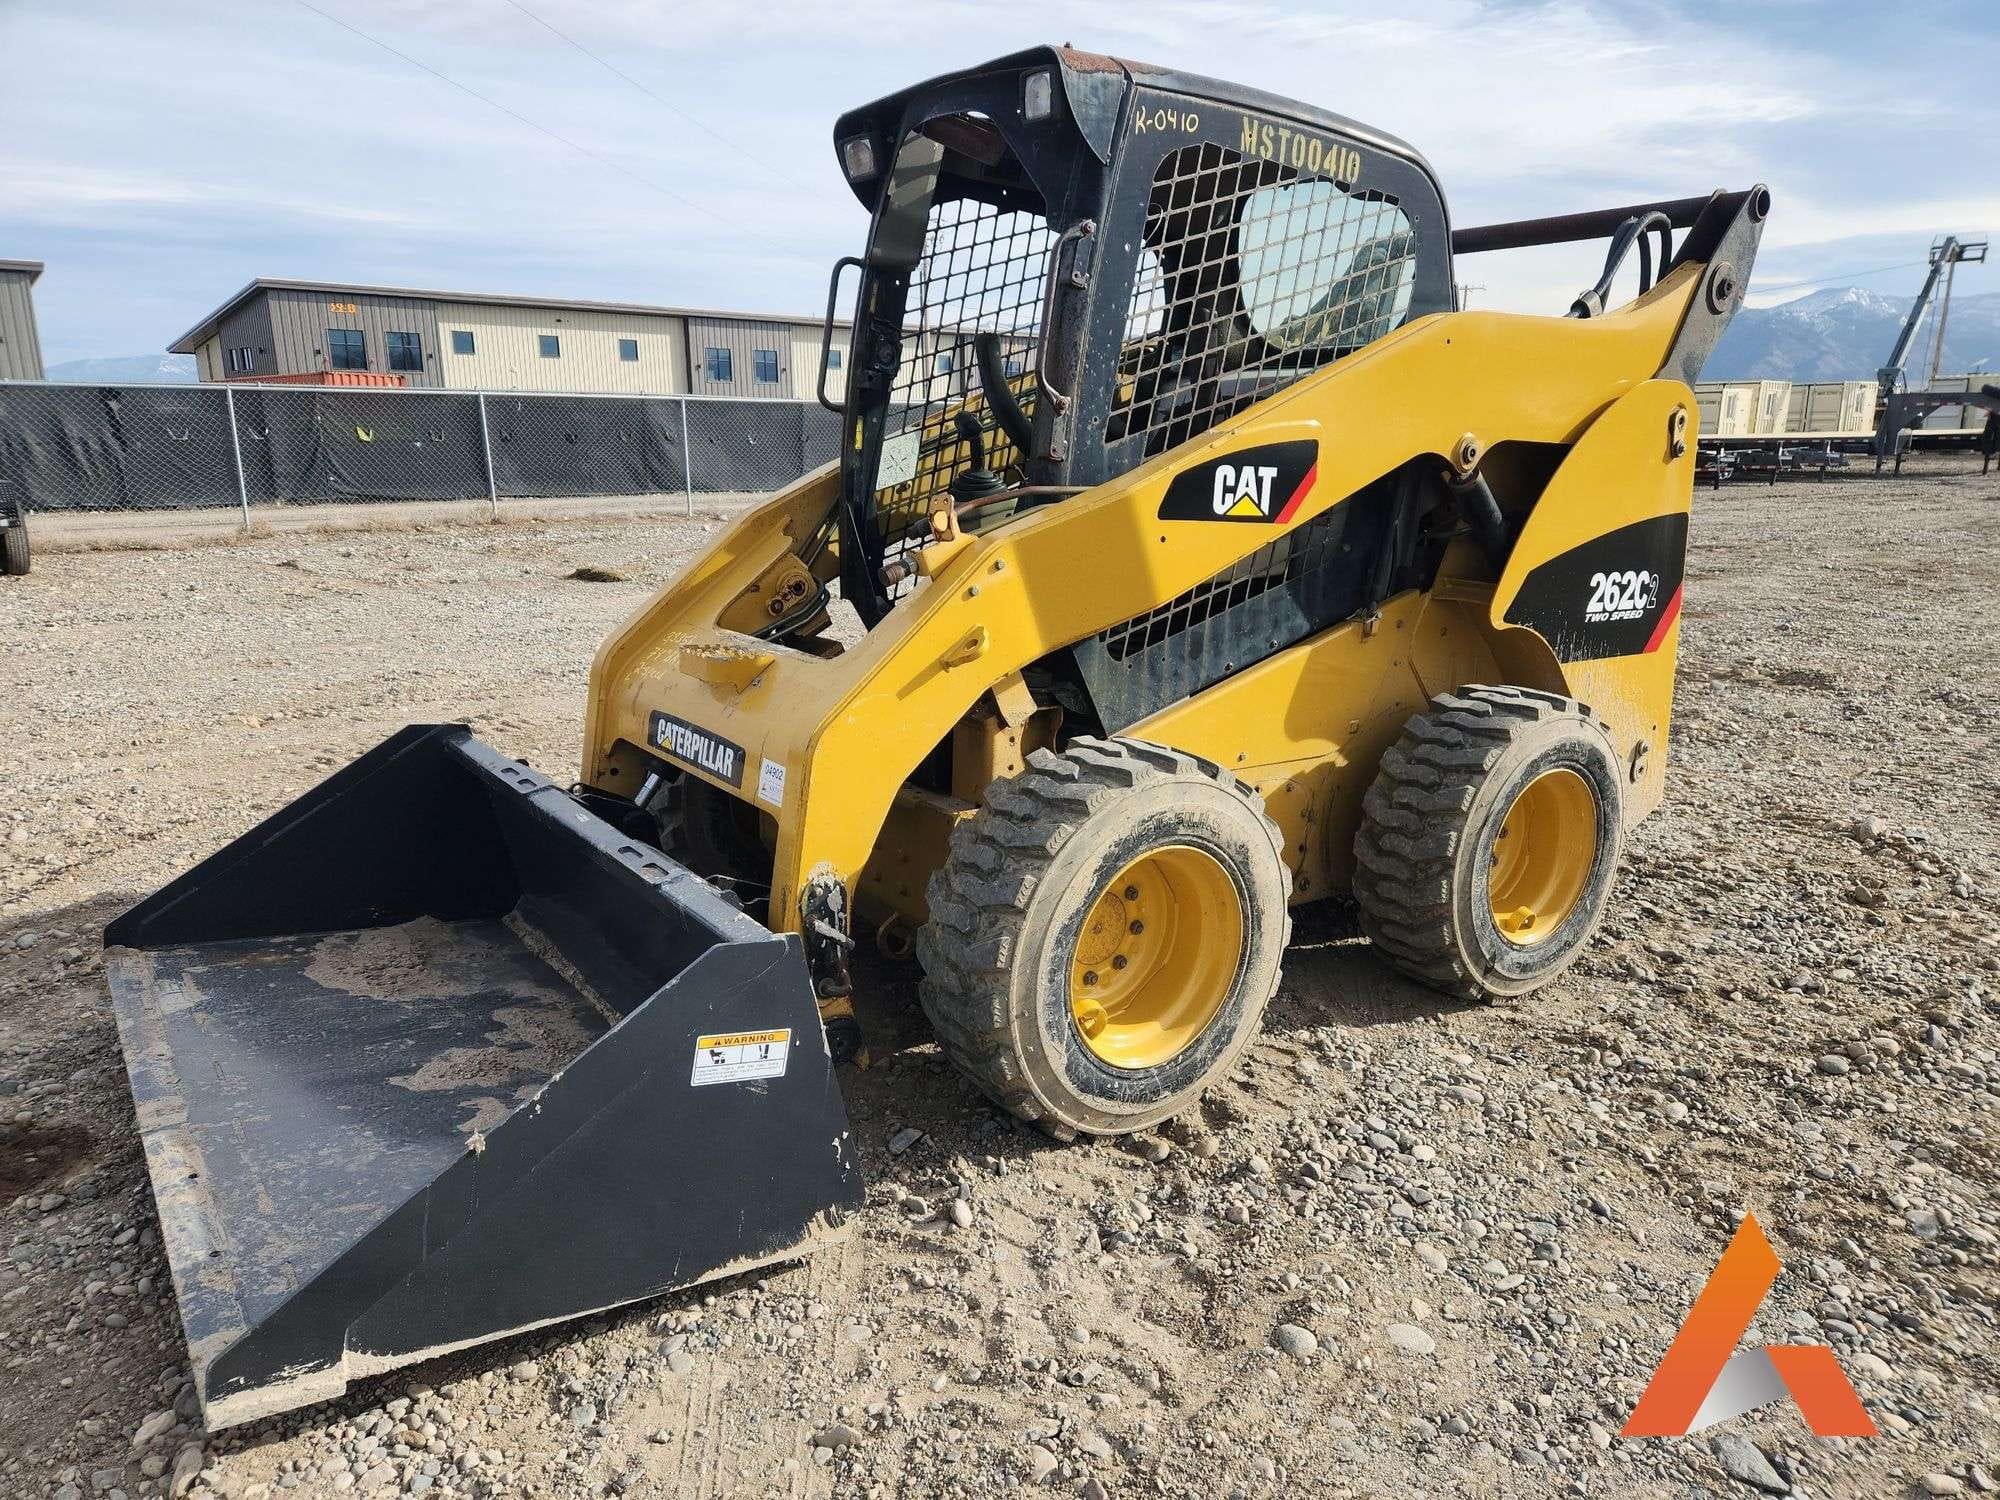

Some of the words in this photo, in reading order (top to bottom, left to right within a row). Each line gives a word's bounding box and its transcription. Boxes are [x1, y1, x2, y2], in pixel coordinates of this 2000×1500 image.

[1240, 116, 1361, 184] MST00410
[1212, 464, 1278, 516] CAT
[1584, 612, 1609, 623] TWO
[1610, 609, 1644, 622] SPEED
[656, 718, 735, 779] CATERPILLAR
[724, 1033, 776, 1045] WARNING
